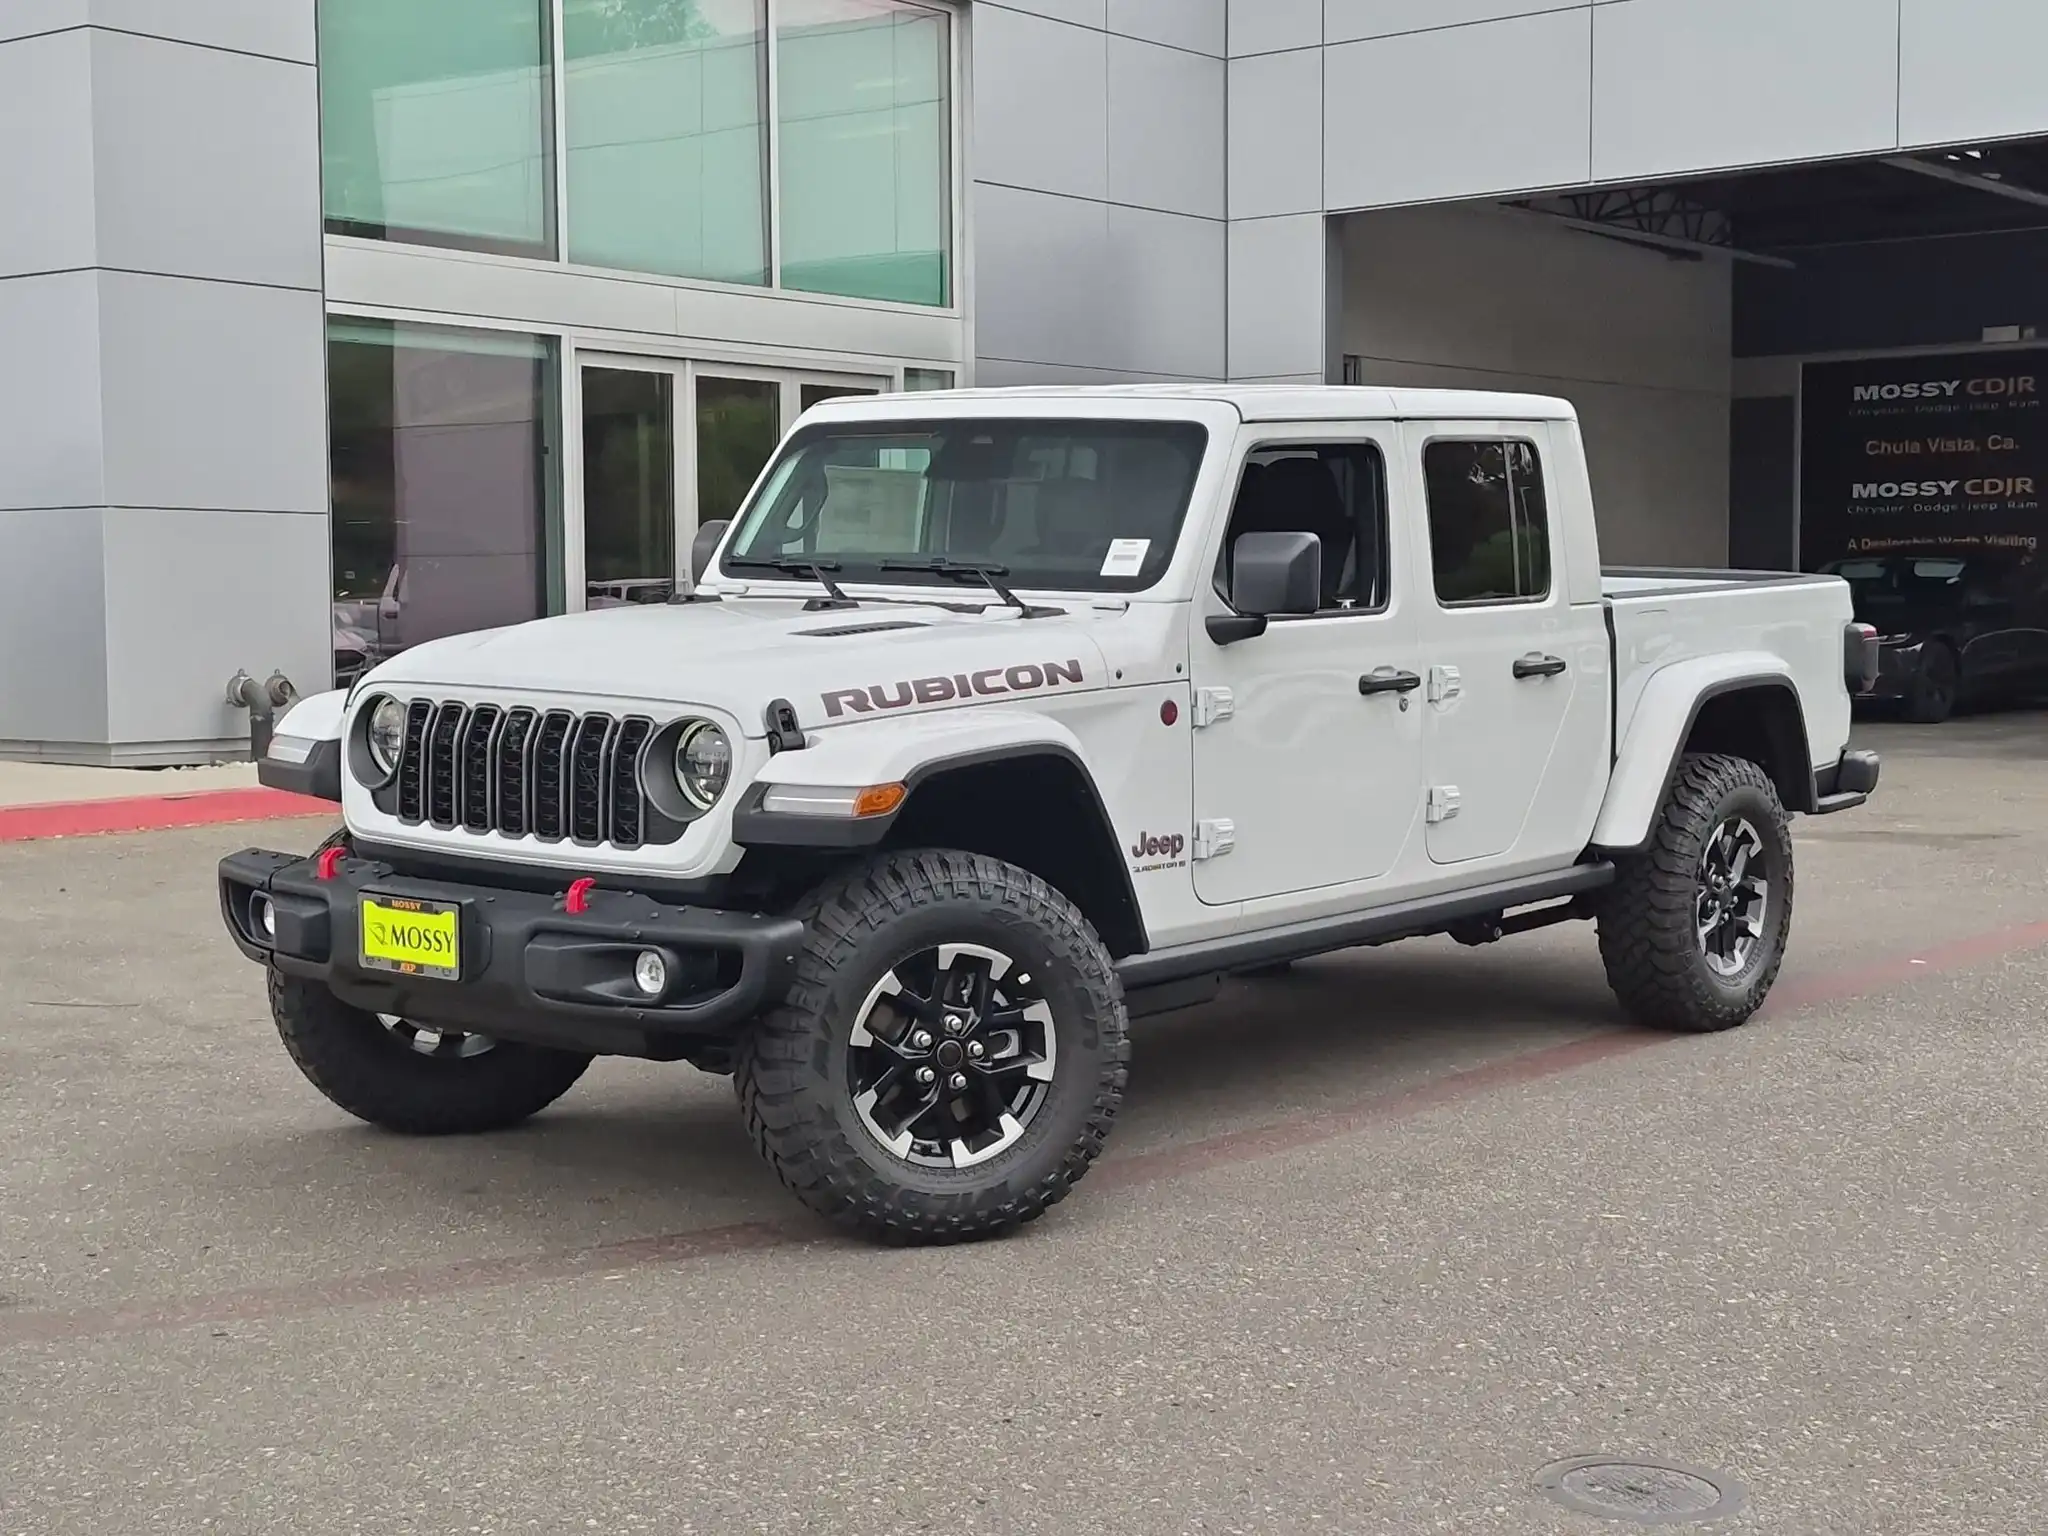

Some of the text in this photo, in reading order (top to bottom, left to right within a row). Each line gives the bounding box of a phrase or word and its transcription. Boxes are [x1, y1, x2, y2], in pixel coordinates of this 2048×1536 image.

[1853, 376, 2036, 401] MOSSY CDJR
[1865, 440, 1921, 456] Chula
[1987, 434, 2020, 451] Ca.
[1852, 477, 2035, 498] MOSSY CDJR
[1912, 502, 1958, 514] Dodge
[2007, 500, 2039, 509] Ram
[1847, 538, 1858, 551] A
[820, 659, 1084, 718] RUBICON
[1131, 831, 1185, 859] Jeep
[391, 899, 422, 911] MOSSY
[391, 924, 454, 954] MOSSY
